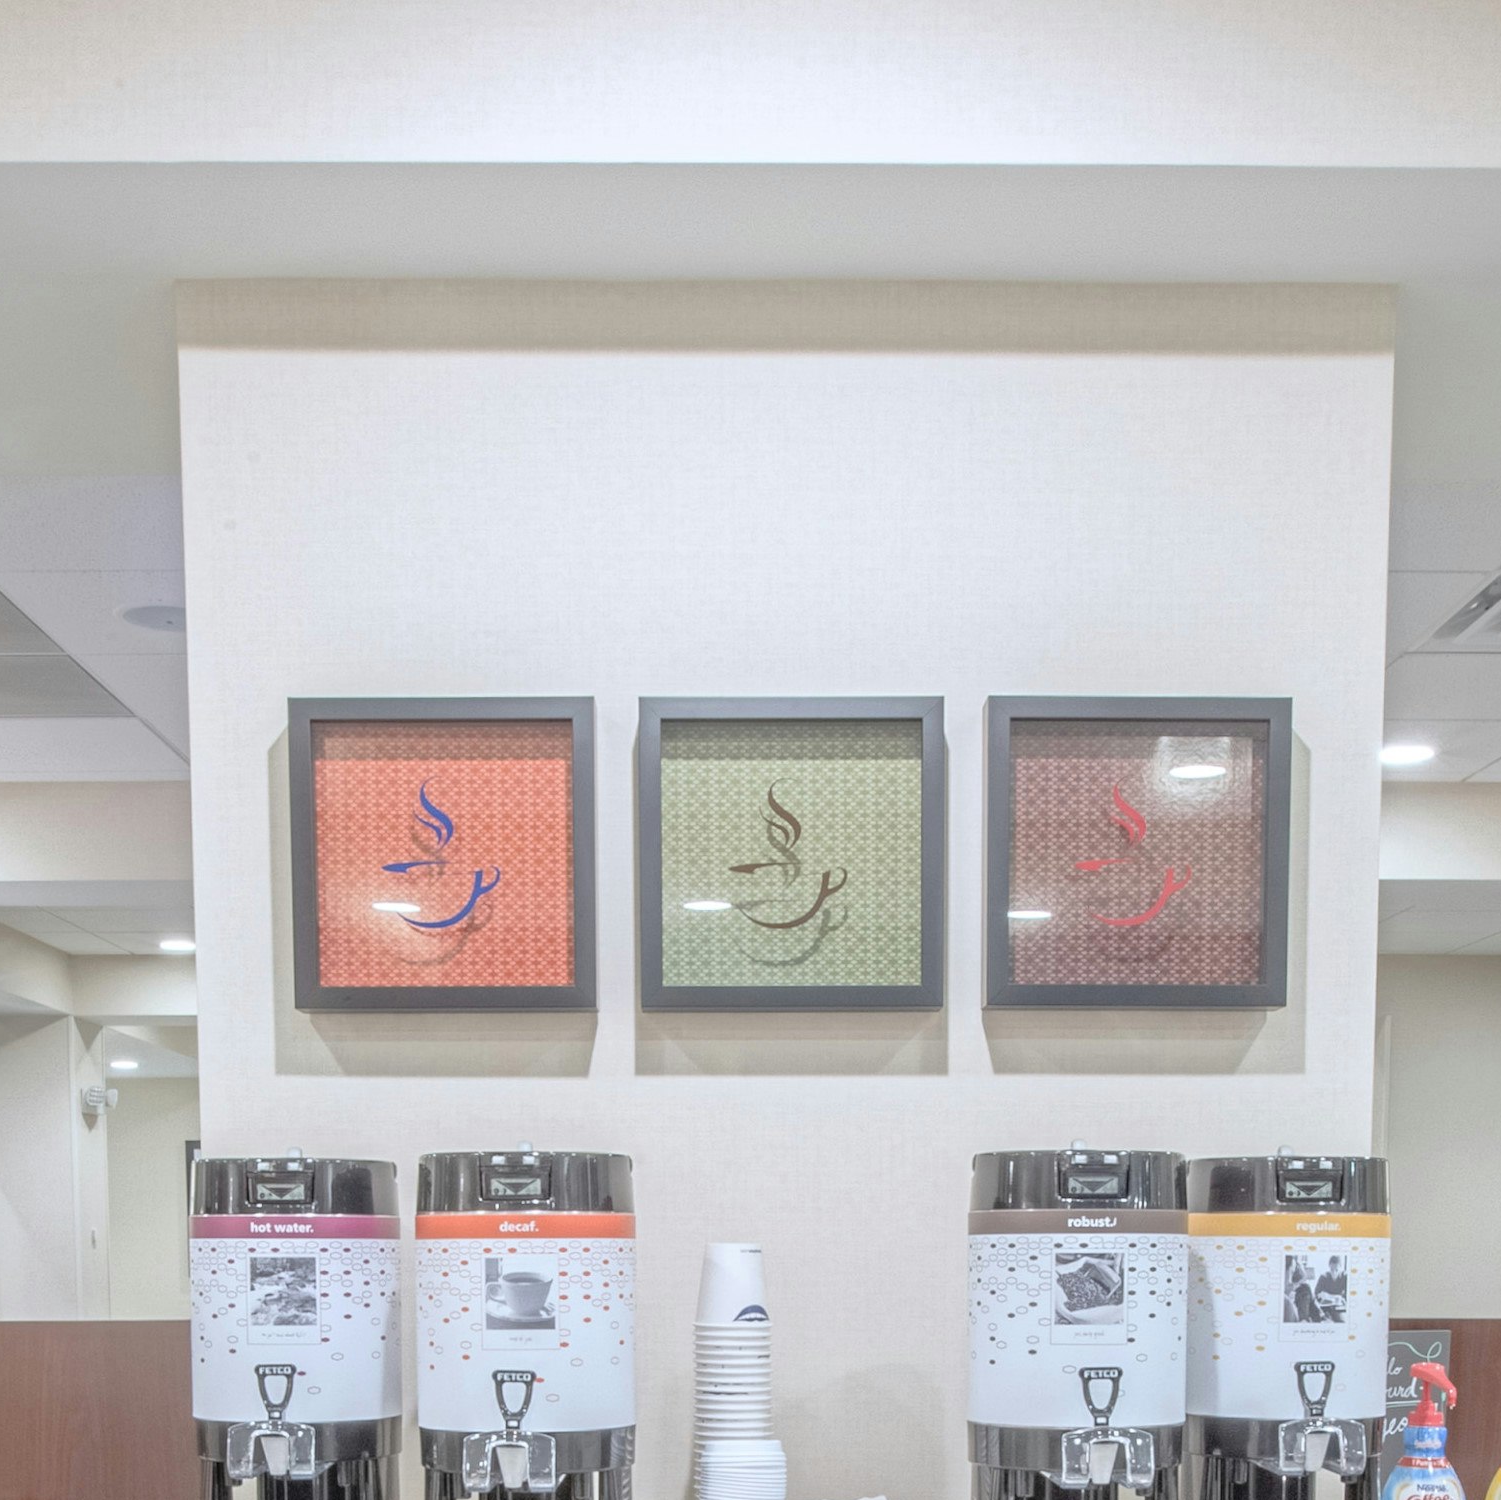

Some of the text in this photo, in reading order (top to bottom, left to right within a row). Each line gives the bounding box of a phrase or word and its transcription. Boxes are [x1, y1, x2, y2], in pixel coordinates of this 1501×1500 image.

[250, 1222, 314, 1233] hot water.
[499, 1221, 540, 1232] decaf.
[1296, 1220, 1342, 1233] regular.
[258, 1366, 292, 1375] FETCO
[1300, 1364, 1333, 1372] FETCO
[496, 1372, 532, 1382] FETCO
[1083, 1369, 1119, 1378] FETCO
